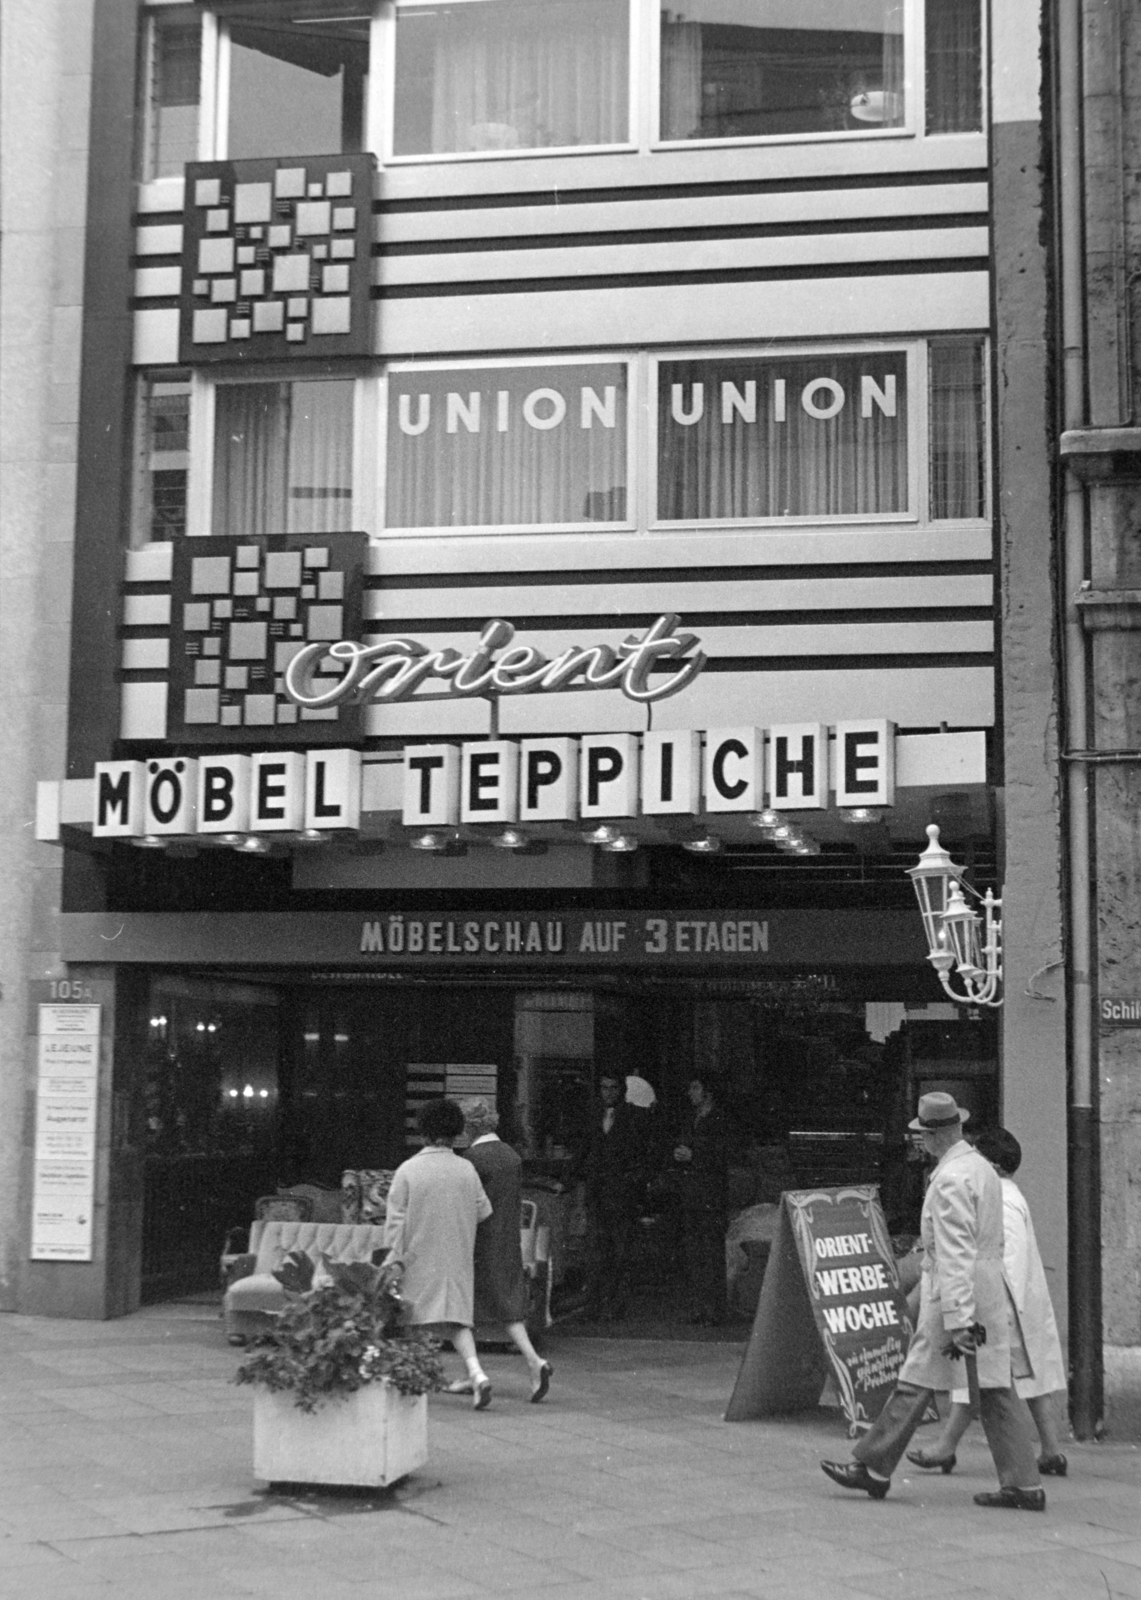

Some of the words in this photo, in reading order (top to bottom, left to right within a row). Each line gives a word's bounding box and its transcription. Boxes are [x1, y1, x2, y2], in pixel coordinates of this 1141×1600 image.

[399, 386, 616, 435] UNION
[671, 375, 896, 425] UNION
[98, 761, 341, 826] MÖBEL
[409, 731, 879, 814] TEPPICHE
[360, 915, 563, 952] MÖBELSCHAU
[579, 921, 627, 952] AUF
[645, 918, 668, 953] 3
[675, 921, 769, 952] ETAGEN
[1102, 999, 1141, 1019] Schil
[815, 1233, 873, 1258] ORIENT-
[816, 1264, 889, 1296] WERBE
[823, 1300, 899, 1334] WOCHE
